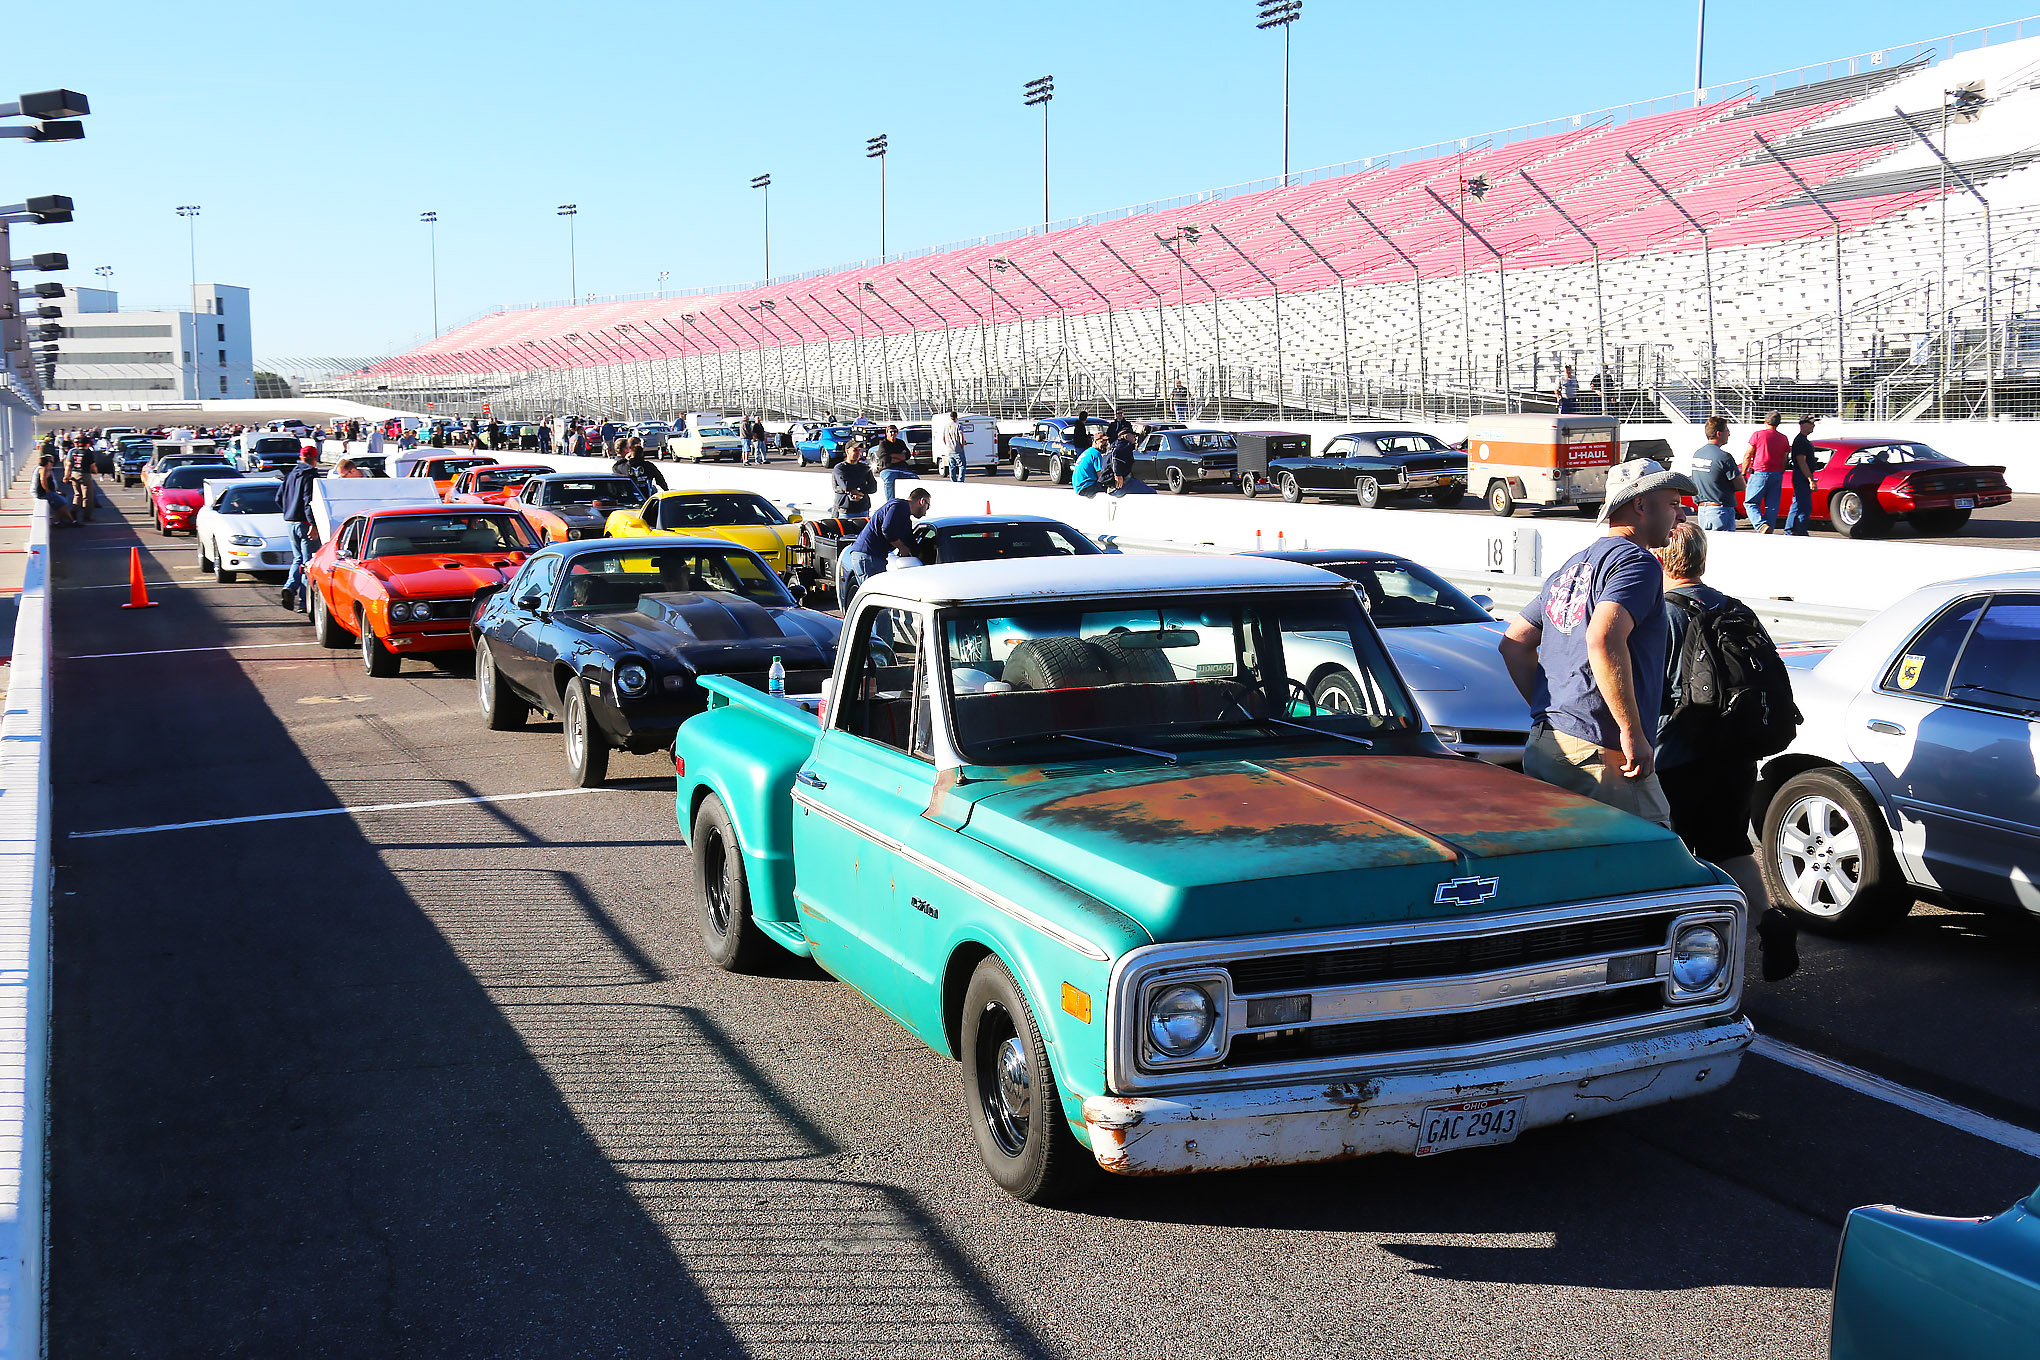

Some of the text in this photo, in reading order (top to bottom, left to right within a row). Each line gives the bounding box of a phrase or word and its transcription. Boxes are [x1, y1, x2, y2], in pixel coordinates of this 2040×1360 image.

[1568, 450, 1608, 460] U-HAUL
[1487, 538, 1503, 566] 18
[1462, 1101, 1488, 1111] OHIO
[1427, 1109, 1516, 1144] GAC 2943
